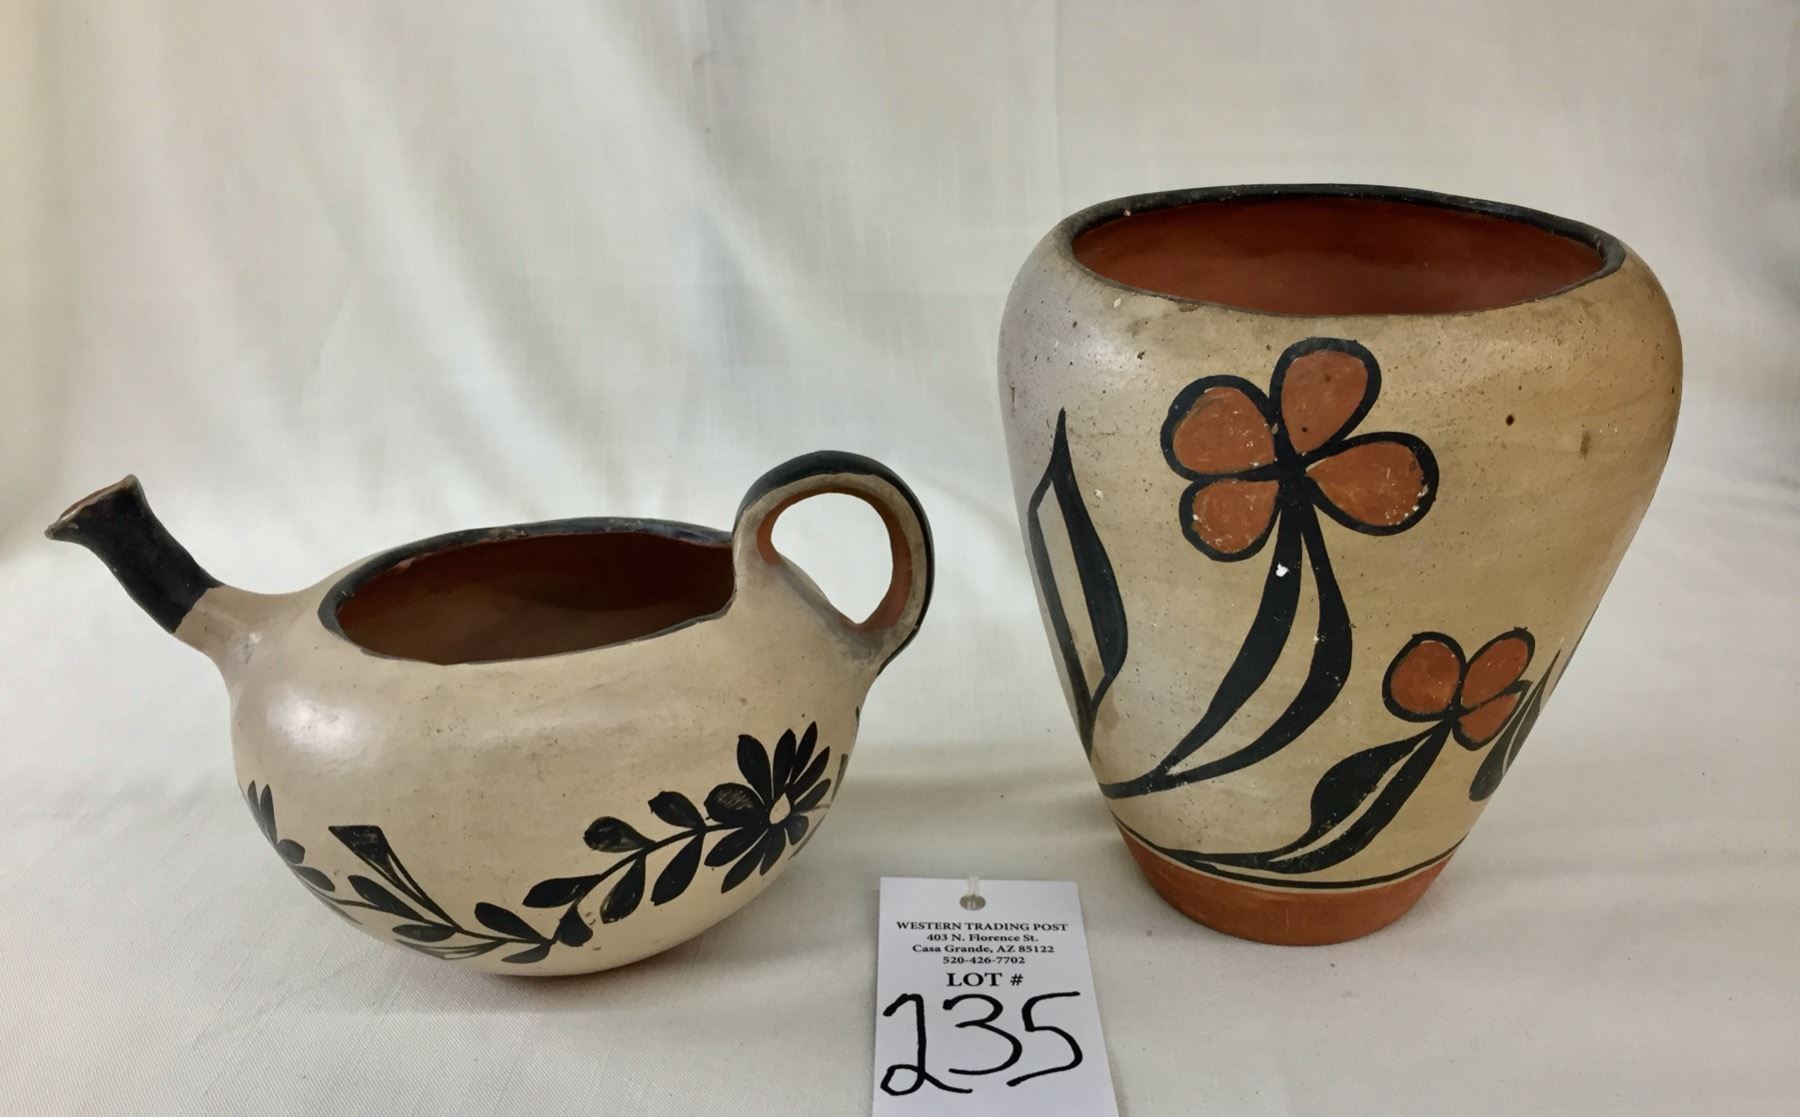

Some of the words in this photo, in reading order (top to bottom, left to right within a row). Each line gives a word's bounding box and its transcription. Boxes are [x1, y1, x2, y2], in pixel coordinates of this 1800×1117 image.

[897, 921, 962, 931] WESTERN
[965, 922, 1030, 931] TRADING
[1033, 922, 1068, 932] POST
[926, 933, 948, 942] 403
[951, 933, 965, 942] N.
[969, 933, 1021, 942] Florence
[1023, 934, 1039, 942] St.
[912, 944, 942, 953] Casa
[944, 944, 993, 954] Grande,
[996, 945, 1016, 953] AZ
[1018, 945, 1055, 953] 85122
[942, 956, 1026, 965] 520-426-7702
[946, 972, 1003, 987] LOT
[1010, 973, 1024, 987] #
[880, 991, 1083, 1096] 235
